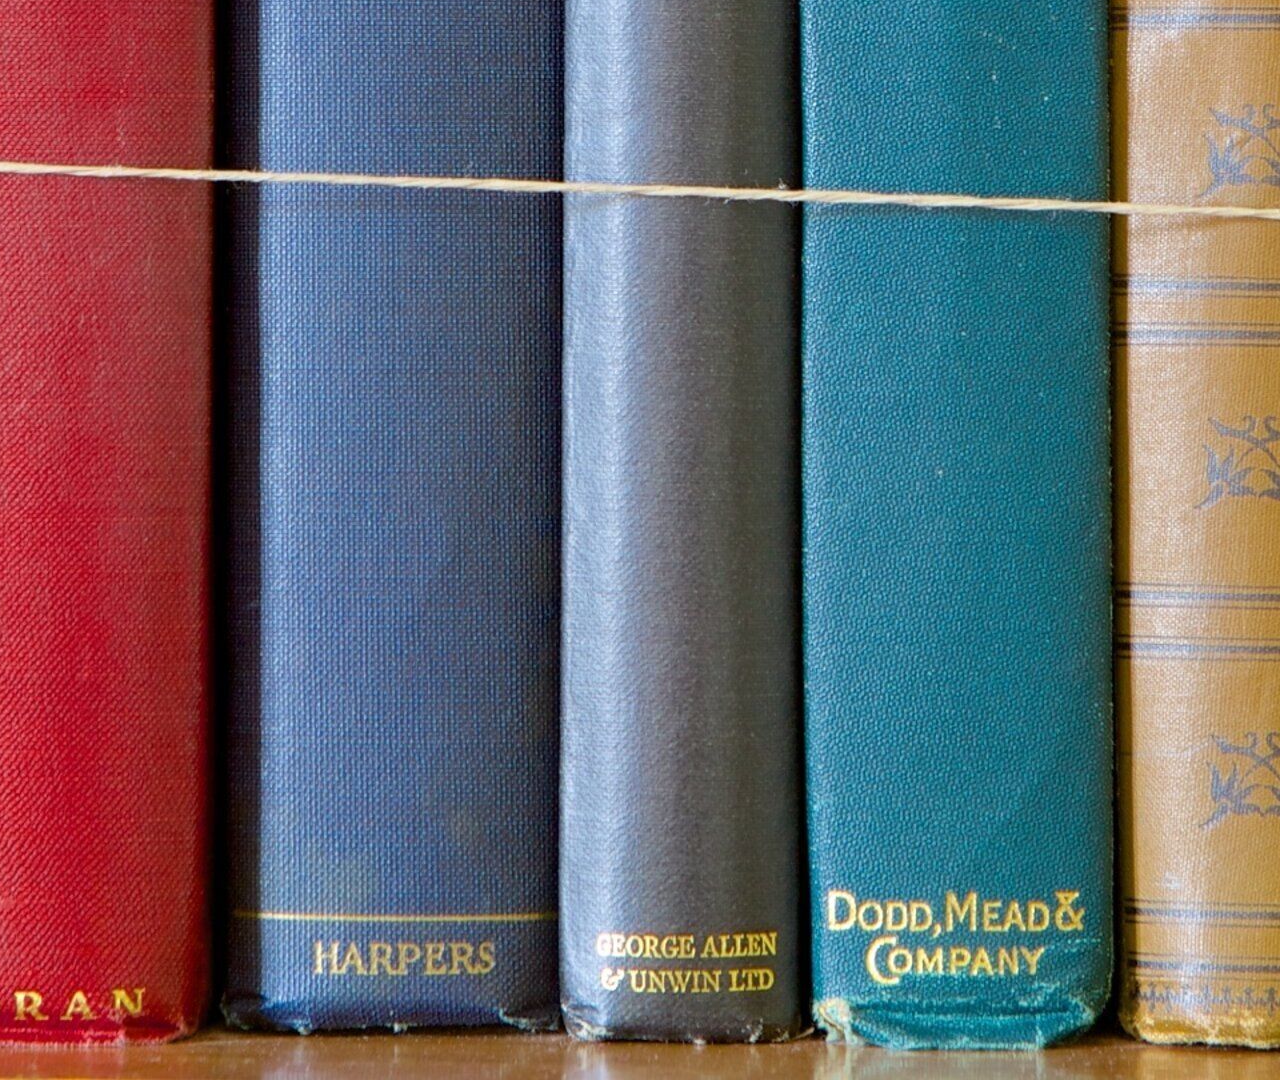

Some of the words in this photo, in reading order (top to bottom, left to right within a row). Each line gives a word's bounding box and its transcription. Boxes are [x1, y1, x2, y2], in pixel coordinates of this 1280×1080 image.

[596, 932, 696, 958] GEORGE
[701, 931, 778, 957] ALLEN
[312, 941, 496, 976] HARPERS
[601, 971, 625, 991] &
[634, 970, 721, 993] UNWIN
[728, 969, 774, 992] LTD
